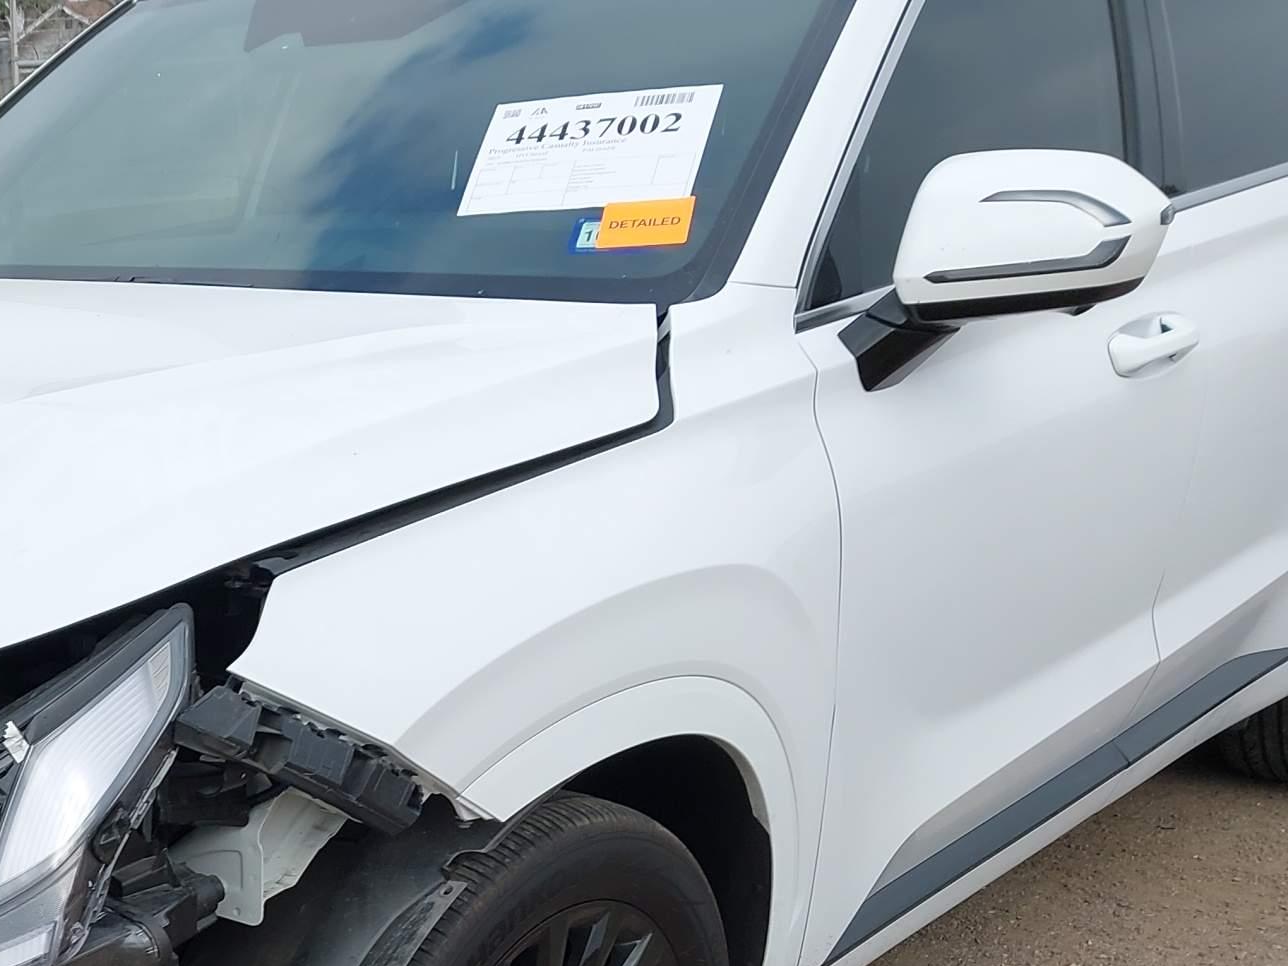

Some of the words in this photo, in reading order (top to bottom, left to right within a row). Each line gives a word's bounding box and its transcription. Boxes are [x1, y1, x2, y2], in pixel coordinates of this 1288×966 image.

[506, 112, 683, 145] 44437002
[608, 216, 681, 230] DETAILED
[584, 230, 600, 243] 1
